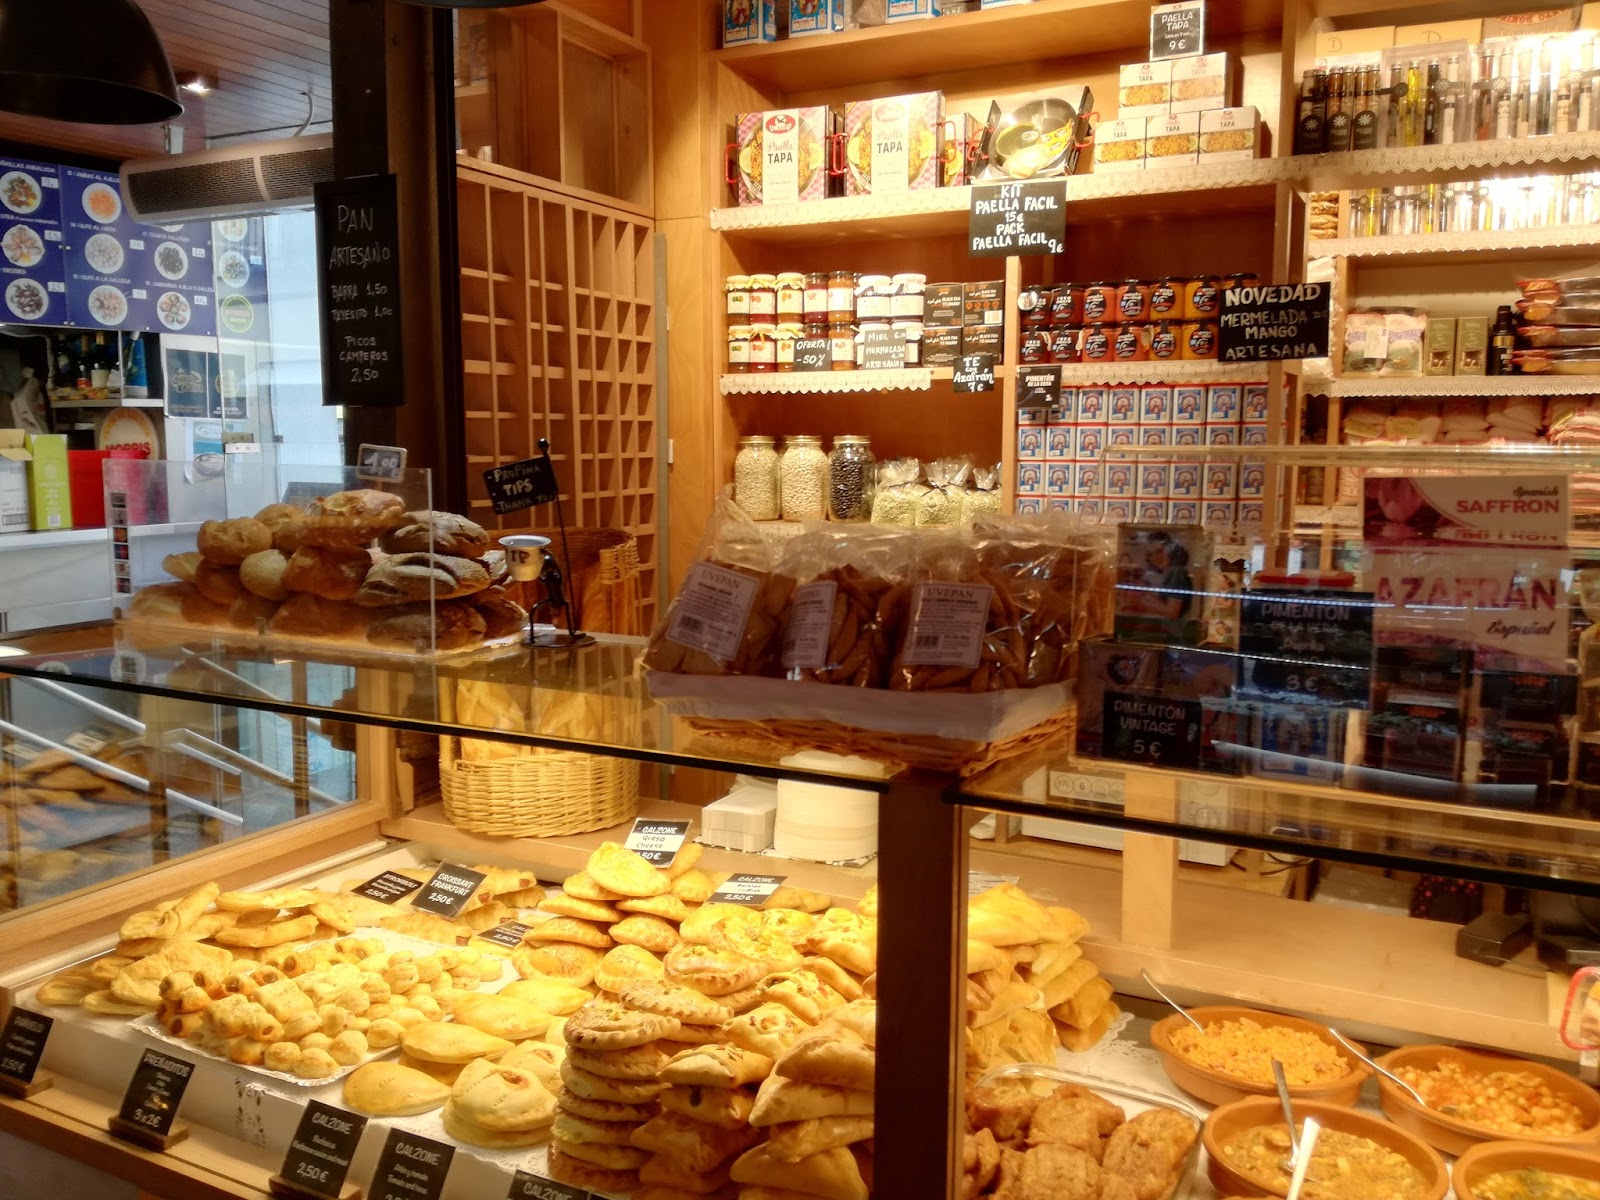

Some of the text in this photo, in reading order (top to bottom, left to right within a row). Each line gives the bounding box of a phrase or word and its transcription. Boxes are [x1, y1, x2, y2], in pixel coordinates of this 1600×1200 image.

[1162, 12, 1193, 24] PAELLA
[1167, 20, 1189, 31] TAPA
[1169, 39, 1186, 50] 9 €
[767, 140, 793, 152] Paella
[877, 141, 903, 154] TAPA
[768, 152, 793, 164] TAPA
[1001, 183, 1024, 199] KIT
[975, 196, 1058, 214] PAELLA FACIL
[337, 204, 373, 233] PAN
[996, 222, 1025, 236] PACK
[972, 235, 1012, 251] PAELLA
[1018, 232, 1048, 246] FACIL
[329, 241, 391, 270] ARTESANO
[330, 285, 358, 302] BARRA
[1225, 284, 1321, 307] NOVEDAD
[1220, 309, 1308, 328] MERMELADA
[867, 331, 889, 343] MIEL
[1245, 325, 1298, 340] MANGO
[344, 335, 376, 347] PICOS
[865, 345, 906, 355] MERMELADA
[1225, 343, 1318, 361] ARTESANA
[963, 357, 981, 367] TE
[953, 368, 994, 384] Azafrán
[503, 478, 534, 496] TIPS
[1512, 486, 1559, 500] Spanish
[1456, 500, 1560, 513] SAFFRON
[702, 570, 741, 589] UVEPAN
[927, 587, 974, 599] UVEPAN
[1486, 619, 1556, 639] Español
[1285, 675, 1300, 691] 3
[1120, 716, 1177, 736] VINTAGE
[1133, 739, 1145, 754] 5
[642, 826, 678, 835] CALZONE
[430, 879, 470, 897] FRANKFURT
[437, 872, 475, 889] CROISSANT
[143, 1053, 191, 1078] PREÑADITOS
[312, 1111, 353, 1136] CALZONE
[395, 1142, 441, 1166] CALZONE
